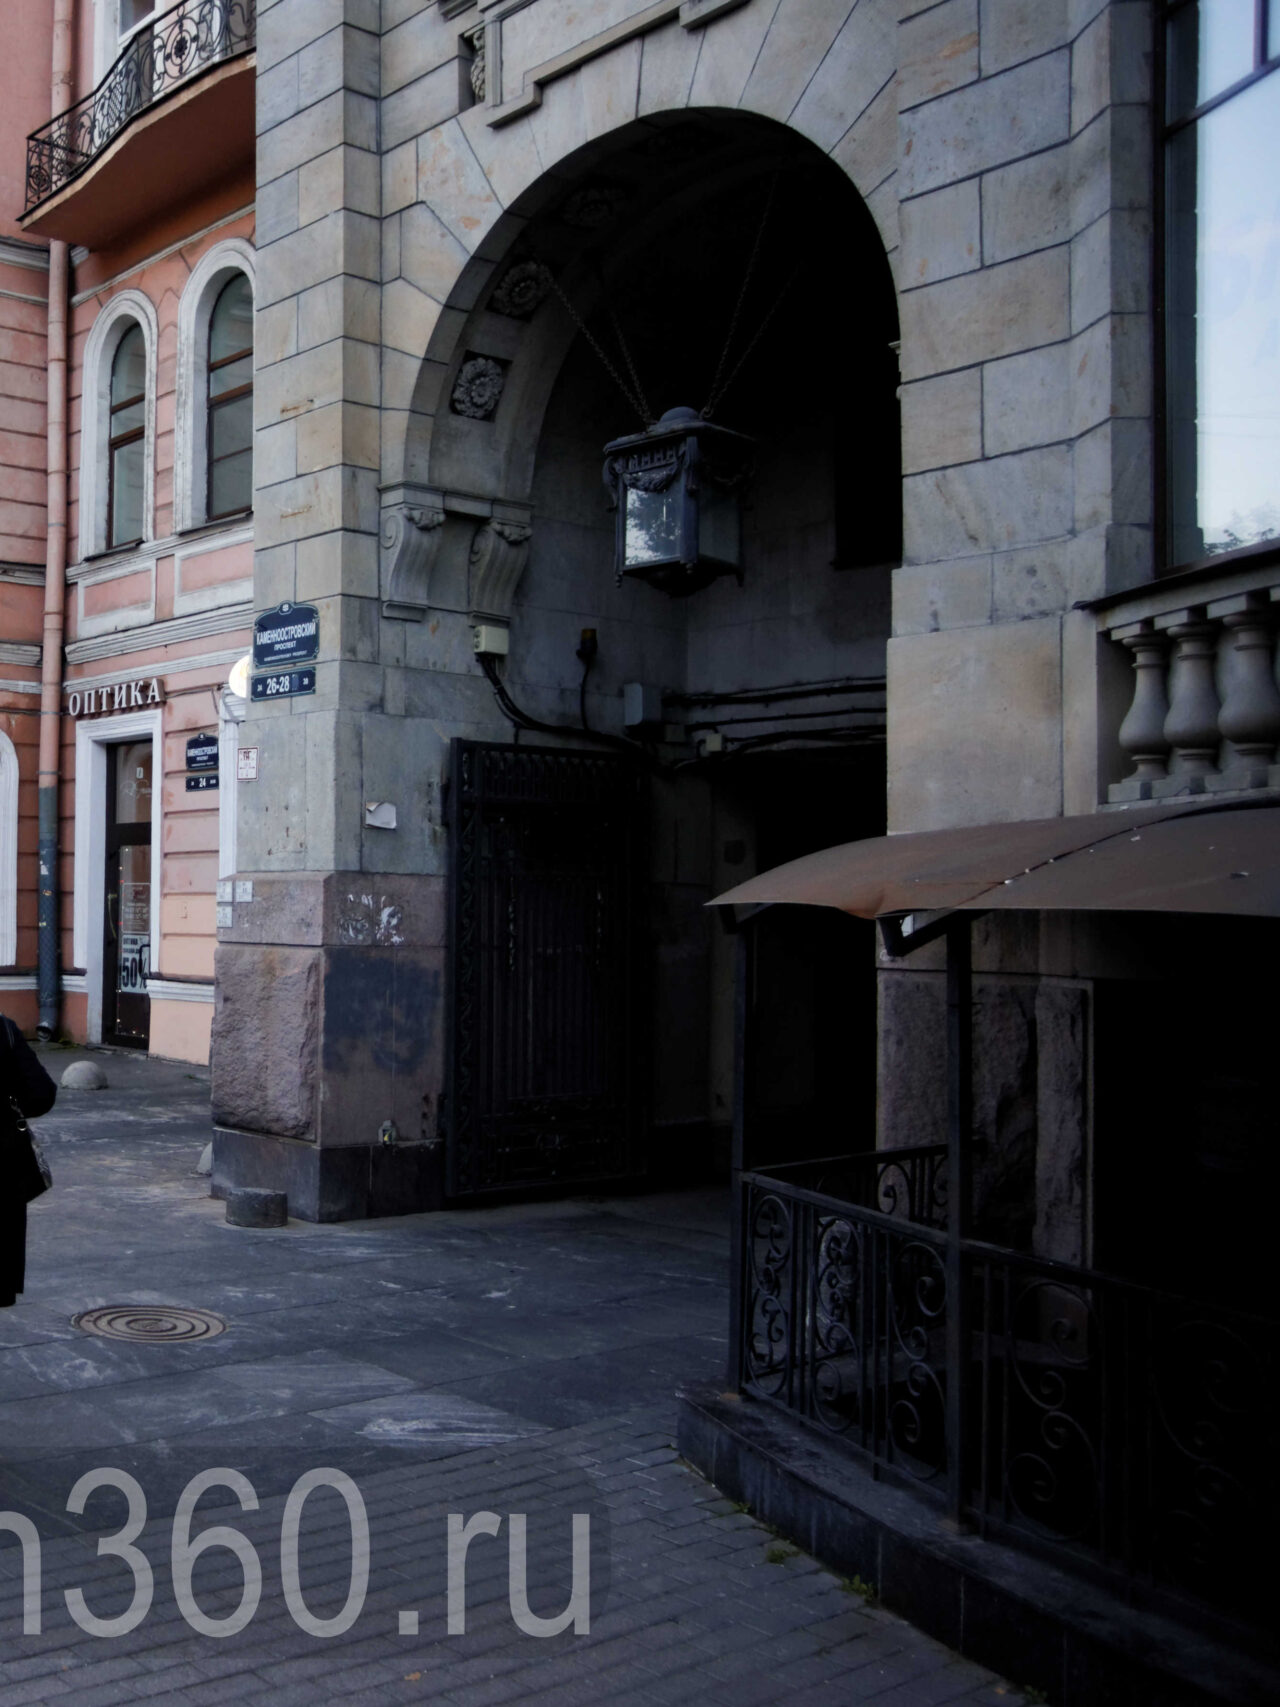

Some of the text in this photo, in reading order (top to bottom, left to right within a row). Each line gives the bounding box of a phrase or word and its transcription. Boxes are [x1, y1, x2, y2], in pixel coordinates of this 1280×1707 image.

[256, 620, 316, 645] КАМЕННООСТРОВСКИЙ
[266, 675, 290, 695] 26-28
[68, 678, 161, 716] ОПТИКА
[198, 777, 207, 788] 24
